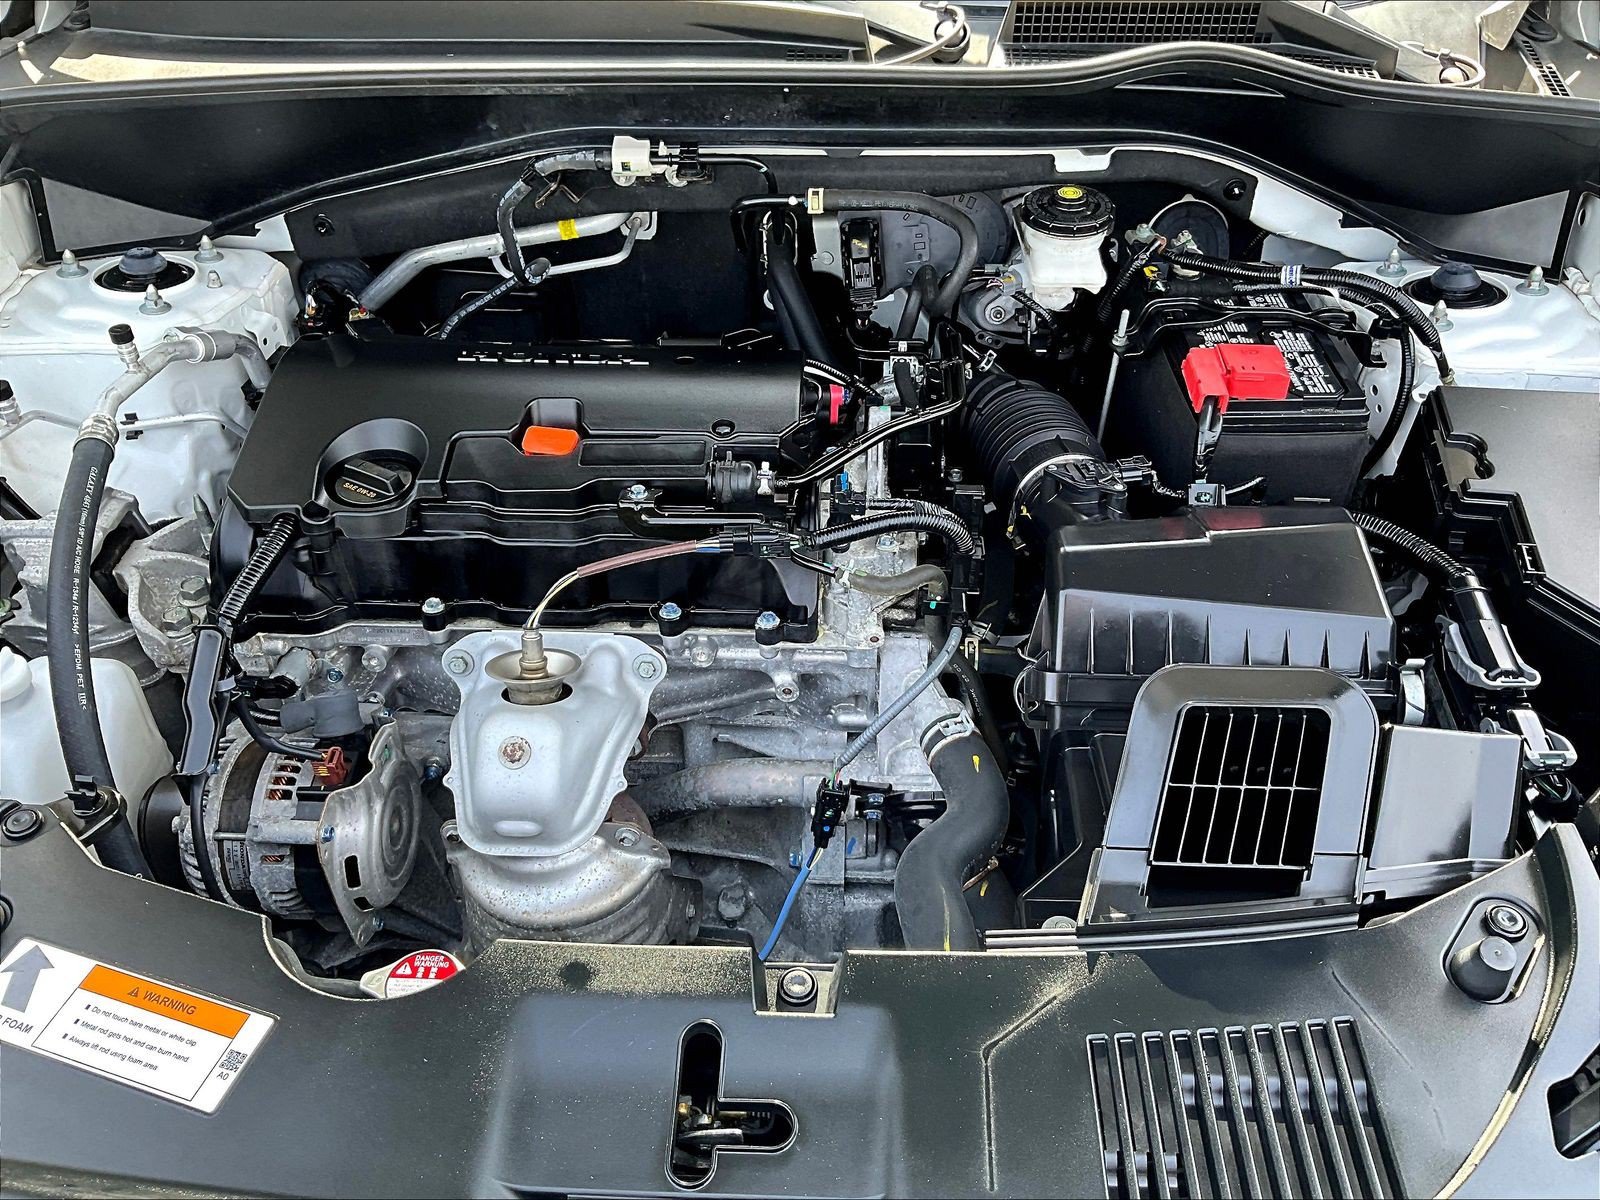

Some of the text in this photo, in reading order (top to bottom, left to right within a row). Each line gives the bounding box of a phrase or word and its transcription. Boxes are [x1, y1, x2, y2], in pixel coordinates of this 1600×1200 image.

[86, 466, 98, 496] GALAXY
[343, 482, 359, 491] SAE
[73, 555, 81, 574] HOSE
[74, 643, 83, 670] >EPDM
[76, 673, 85, 689] PET
[143, 990, 197, 1015] WARNING
[1, 1016, 34, 1035] FOAM
[91, 1006, 102, 1015] Do
[101, 1010, 113, 1018] not
[112, 1013, 129, 1023] touch
[128, 1019, 144, 1029] bare
[143, 1024, 162, 1035] metal
[168, 1033, 186, 1043] white
[185, 1039, 197, 1047] clip
[69, 1035, 91, 1048] Always
[90, 1042, 100, 1051] lift
[98, 1046, 111, 1055] rod
[110, 1050, 127, 1062] using
[127, 1055, 143, 1066] foam
[80, 1020, 99, 1031] Metal
[97, 1027, 109, 1035] rod
[107, 1031, 122, 1040] gets
[121, 1035, 134, 1044] hot
[132, 1039, 146, 1048] and
[145, 1043, 158, 1051] can
[156, 1047, 173, 1057] burn
[216, 1071, 230, 1081] A0
